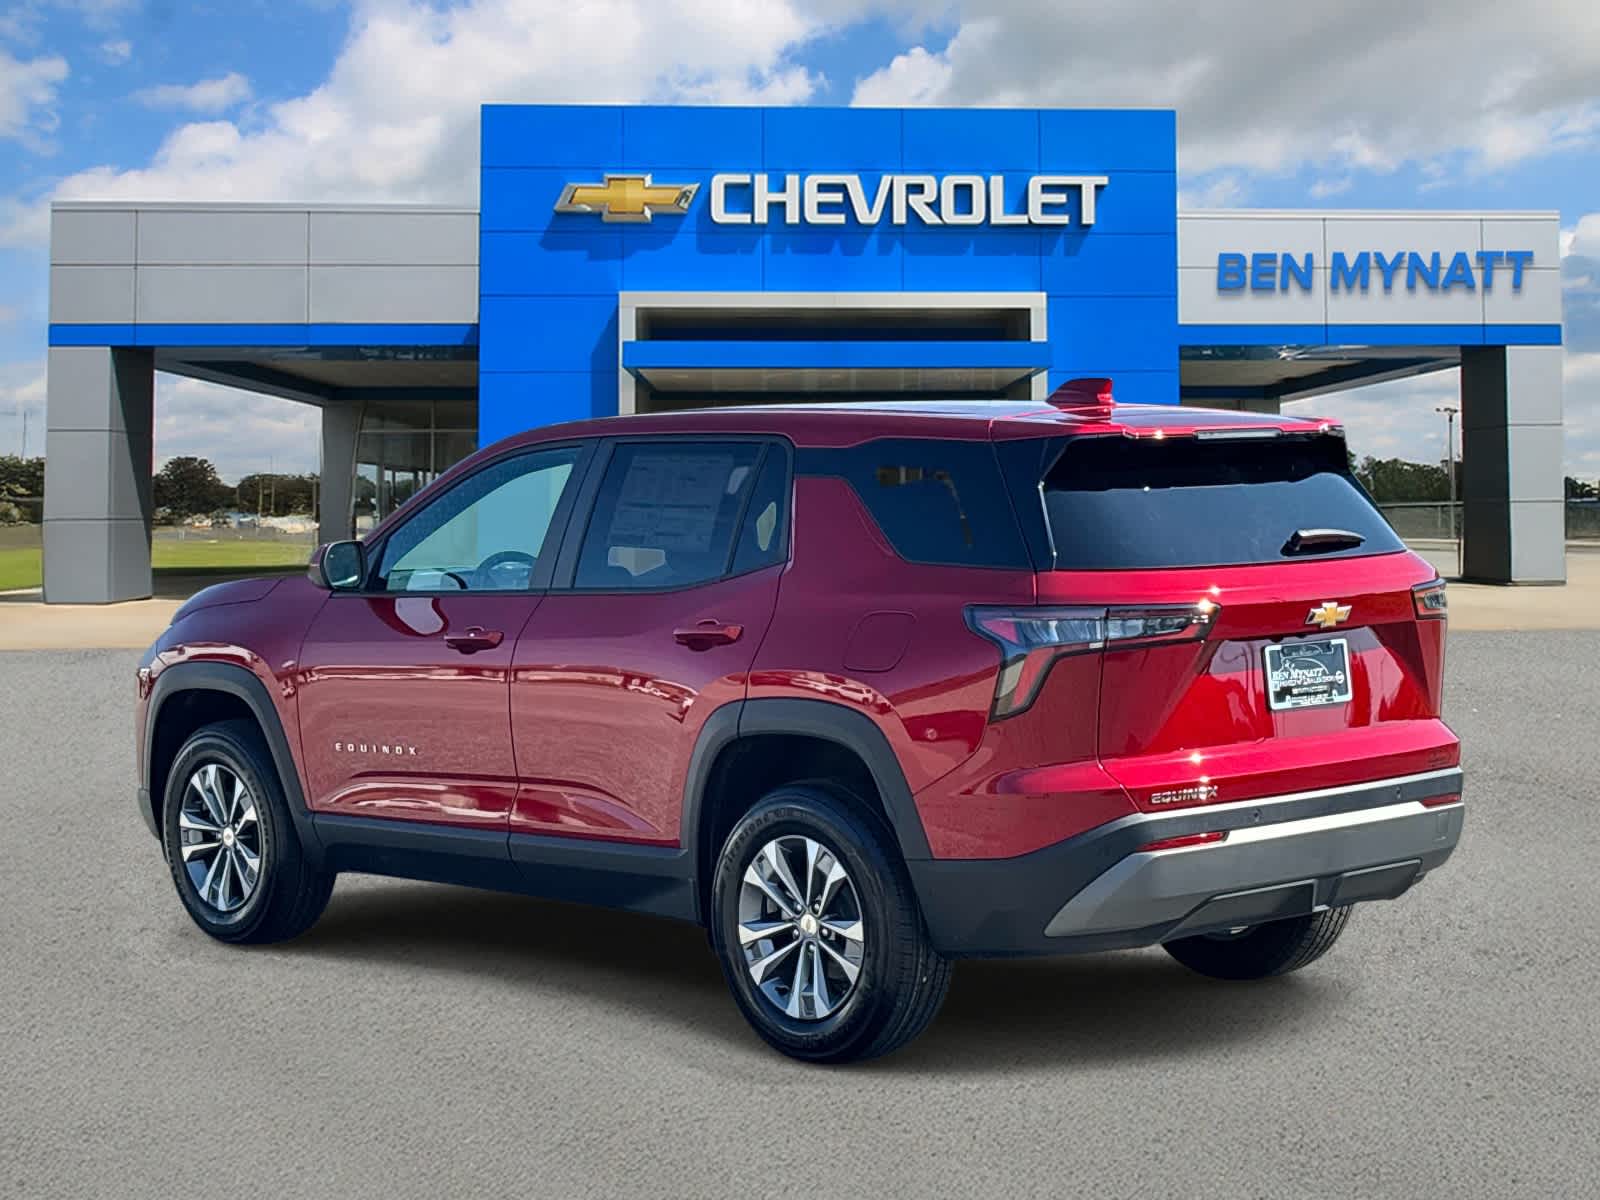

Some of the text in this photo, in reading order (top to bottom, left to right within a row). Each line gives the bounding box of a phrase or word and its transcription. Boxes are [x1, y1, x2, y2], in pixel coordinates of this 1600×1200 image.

[710, 174, 1109, 225] CHEVROLET
[1217, 251, 1534, 290] BEN MYNATT
[335, 742, 417, 756] EQUINOX
[1151, 785, 1218, 804] EQUINOX
